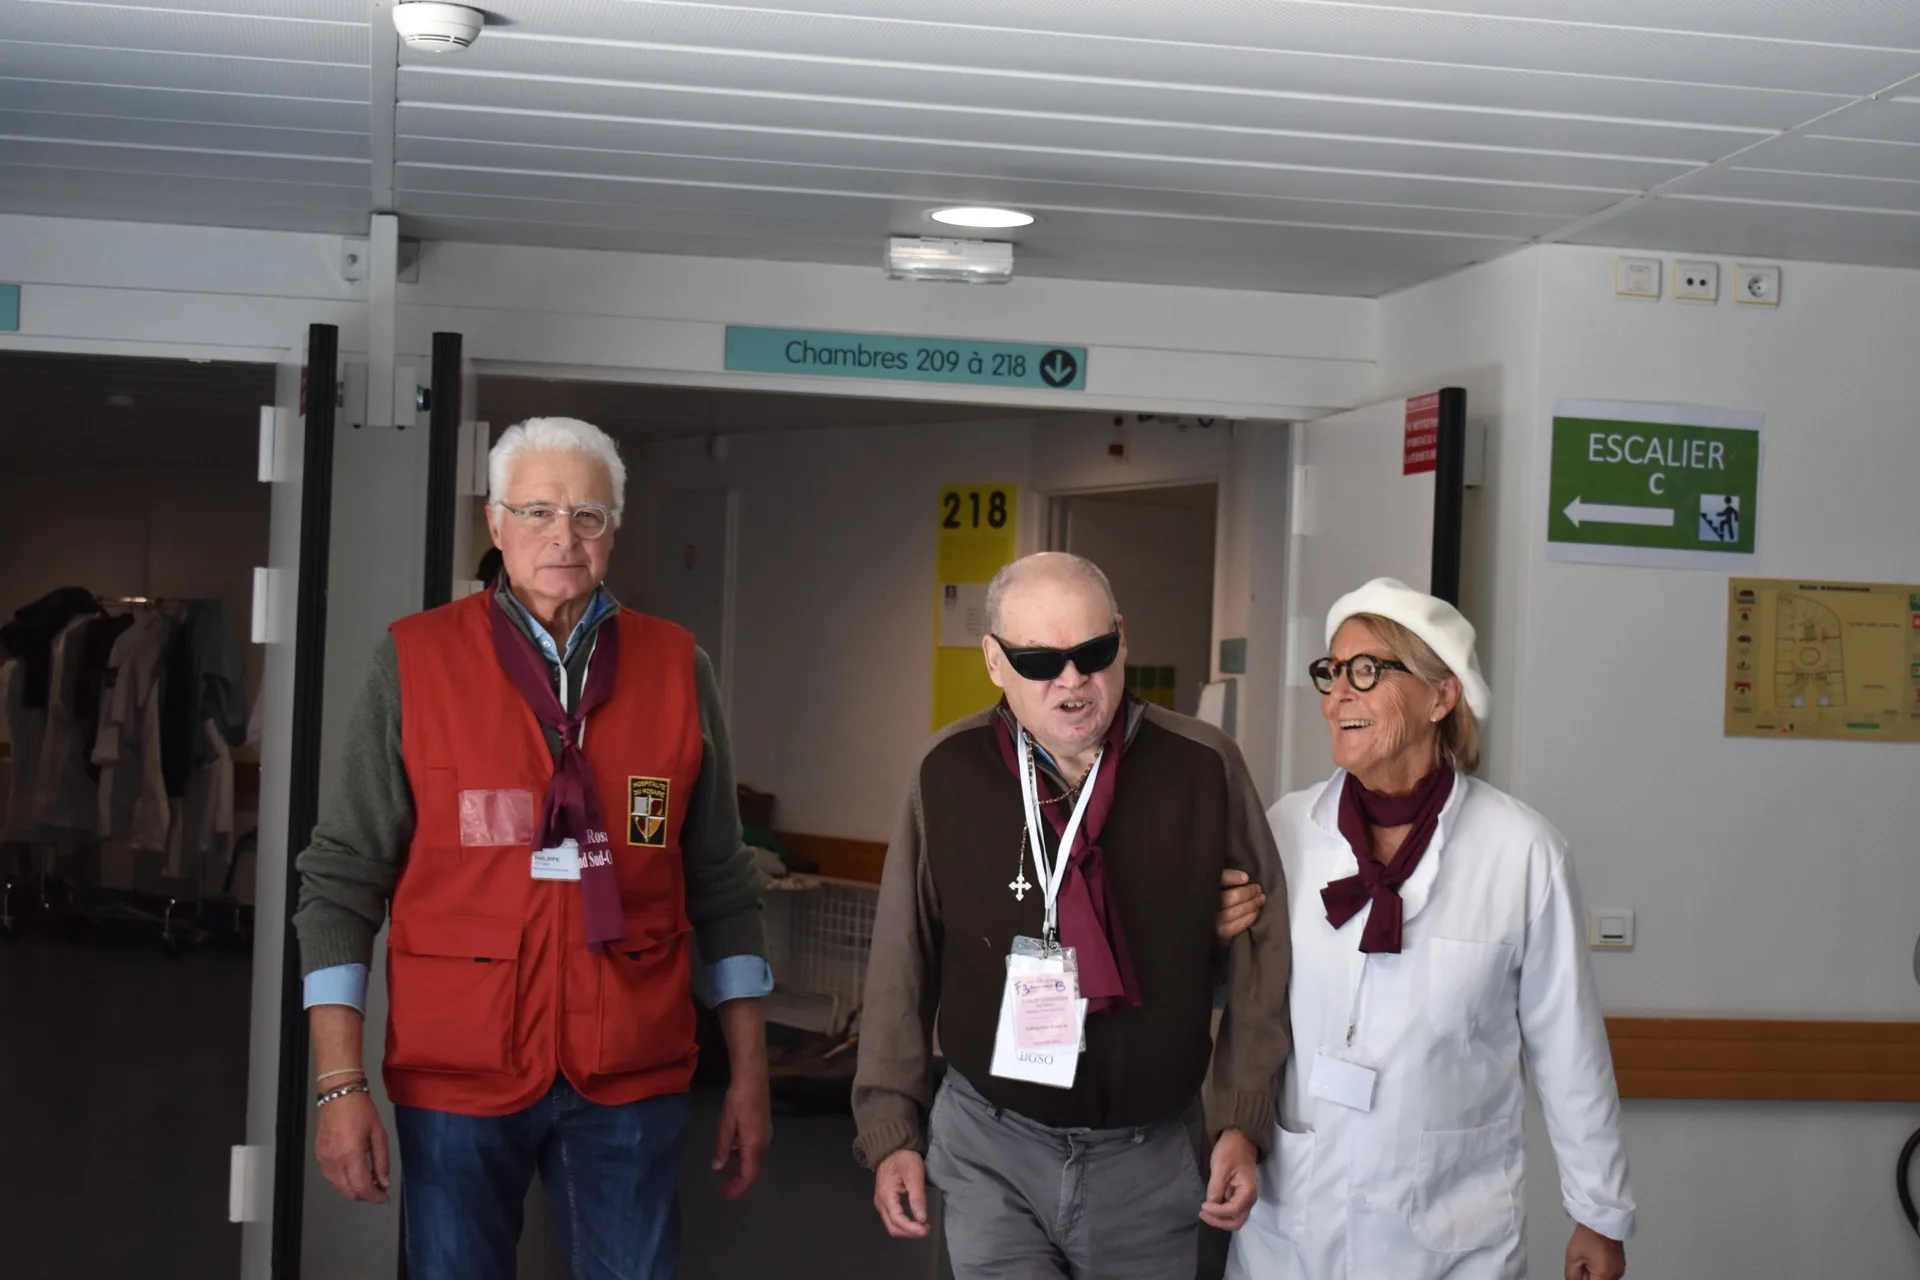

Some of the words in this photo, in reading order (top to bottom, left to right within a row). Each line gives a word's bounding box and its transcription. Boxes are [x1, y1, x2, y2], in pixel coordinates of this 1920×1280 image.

[785, 340, 908, 370] Chambres
[916, 348, 960, 373] 209
[968, 352, 983, 375] à
[991, 353, 1027, 378] 218
[1588, 432, 1725, 470] ESCALIER
[1649, 472, 1666, 495] C
[943, 491, 1007, 529] 218
